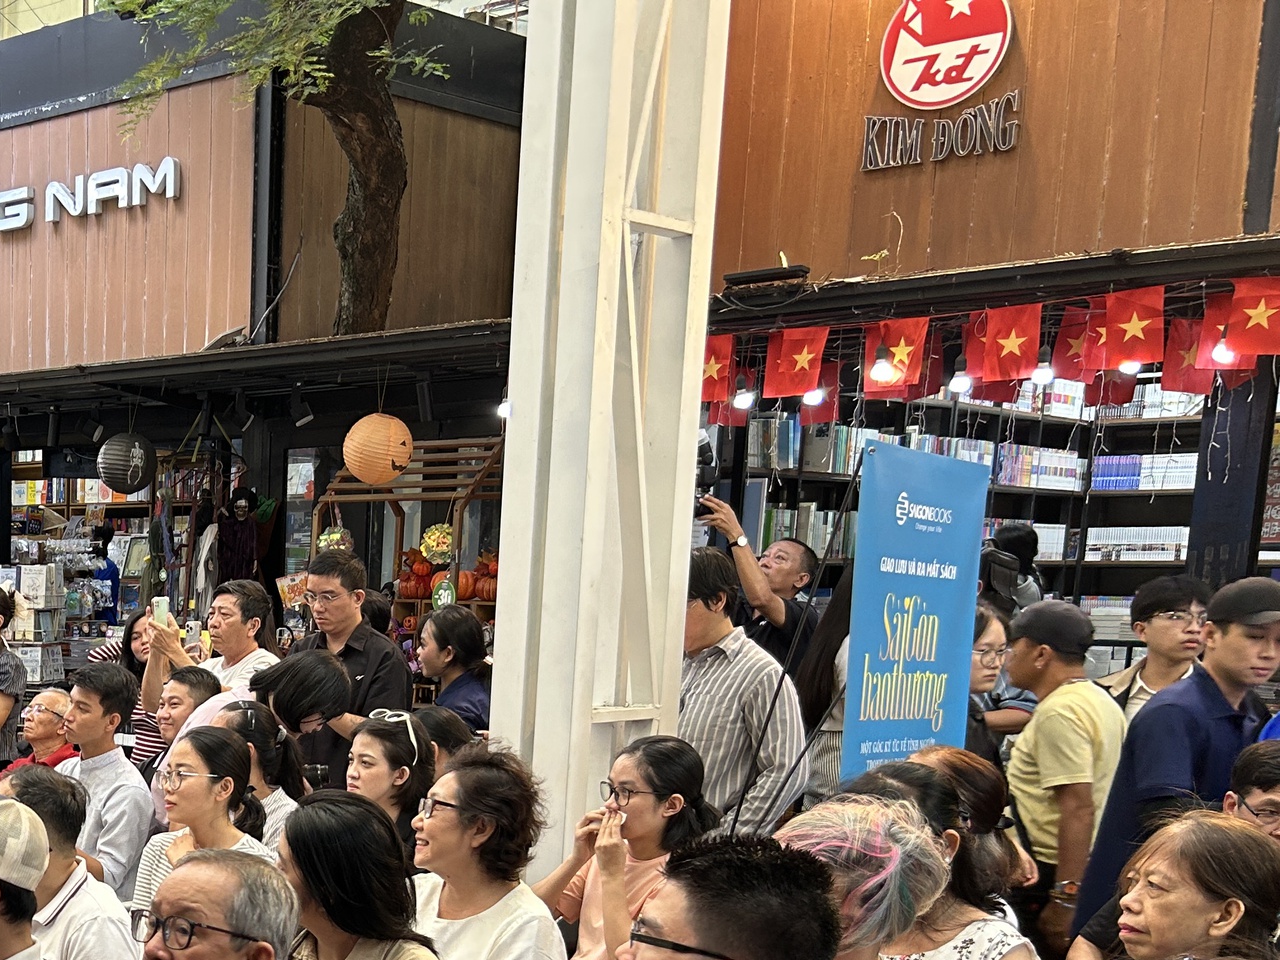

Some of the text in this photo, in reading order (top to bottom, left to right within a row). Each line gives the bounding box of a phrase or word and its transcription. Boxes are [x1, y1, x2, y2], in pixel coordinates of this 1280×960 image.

[860, 115, 925, 172] KIM
[45, 156, 182, 223] NAM
[880, 557, 894, 572] GIAO
[916, 561, 925, 576] RA
[940, 562, 957, 580] SÁCH
